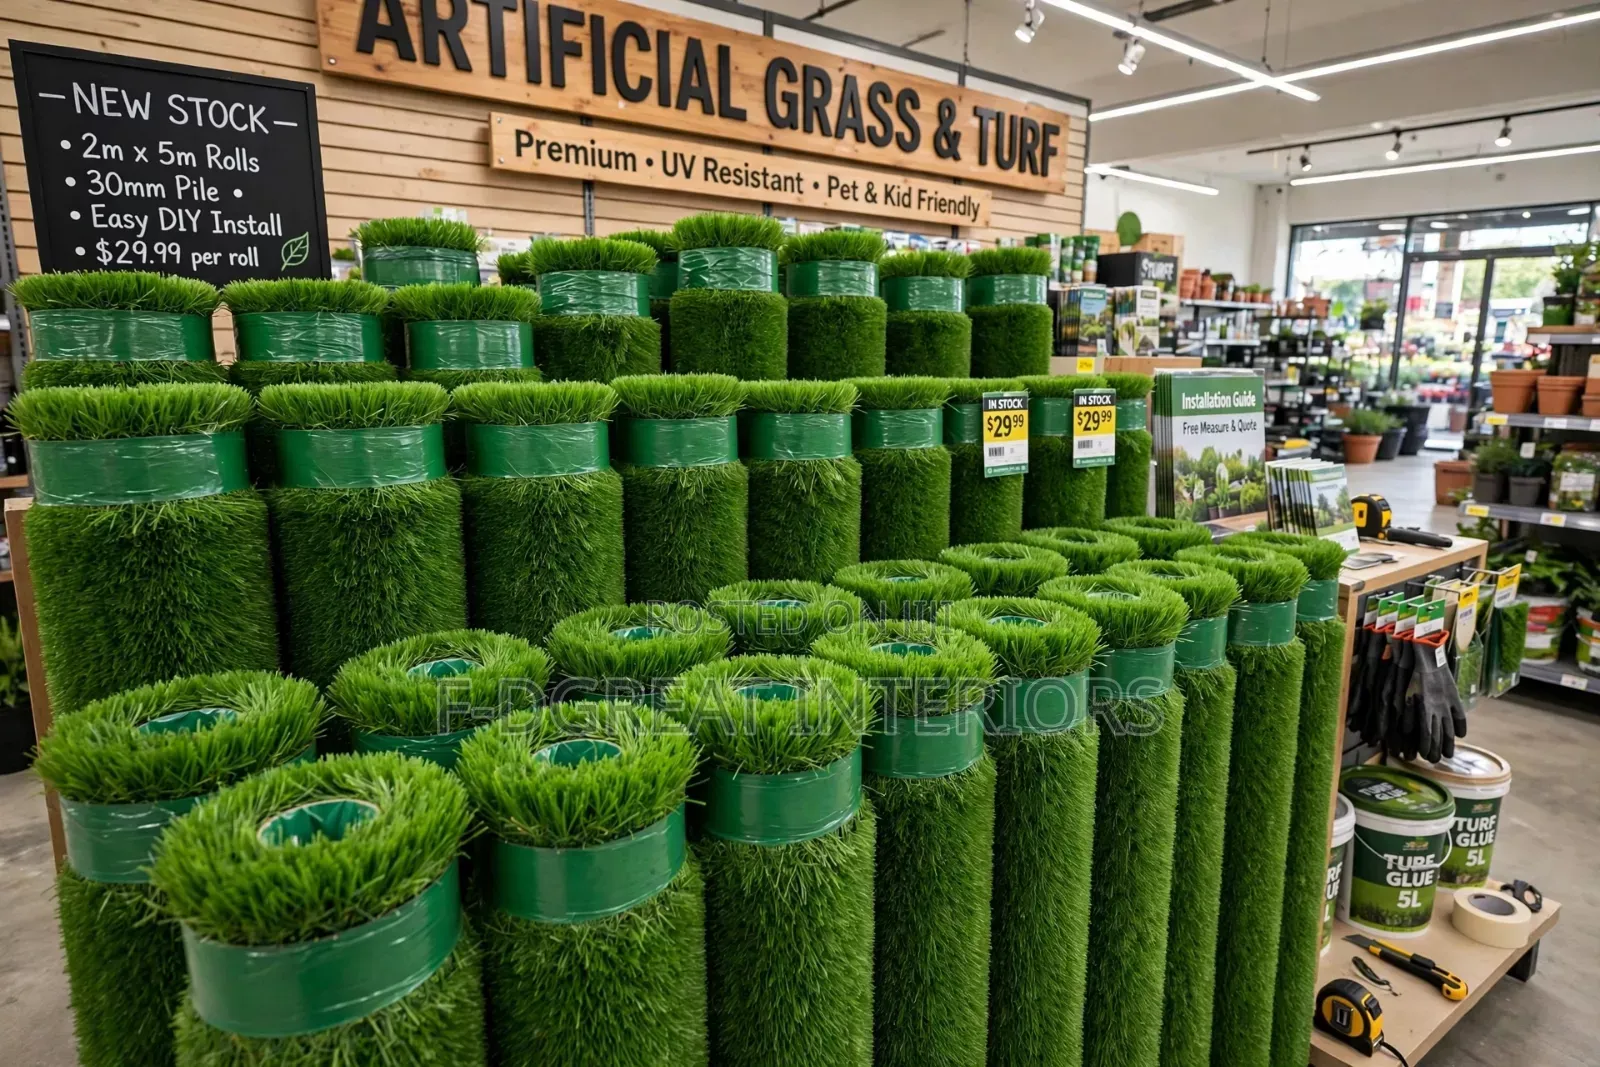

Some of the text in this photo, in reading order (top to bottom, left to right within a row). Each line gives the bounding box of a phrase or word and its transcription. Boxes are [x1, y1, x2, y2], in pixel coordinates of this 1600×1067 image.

[355, 0, 1061, 177] ARTIFICIAL GRASS & TURF
[72, 82, 269, 134] NEW STOCK
[81, 132, 260, 173] 2m x 5m Rolls
[514, 128, 980, 222] Premium UV Resistant Pet & Kid Friendly
[86, 169, 220, 202] 30mm Pile
[91, 204, 282, 238] Easy DIY Install
[96, 237, 259, 272] $29.99 per roll
[988, 398, 1023, 409] IN STOCK
[1078, 394, 1112, 405] IN STOCK
[1181, 390, 1256, 410] Installation Guide
[1183, 419, 1257, 435] Free Measure & Quote
[1453, 815, 1497, 832] TURF
[1456, 830, 1494, 847] GLUE
[1465, 849, 1485, 866] 5L
[1386, 870, 1434, 887] GLUE
[1397, 891, 1422, 908] 5L
